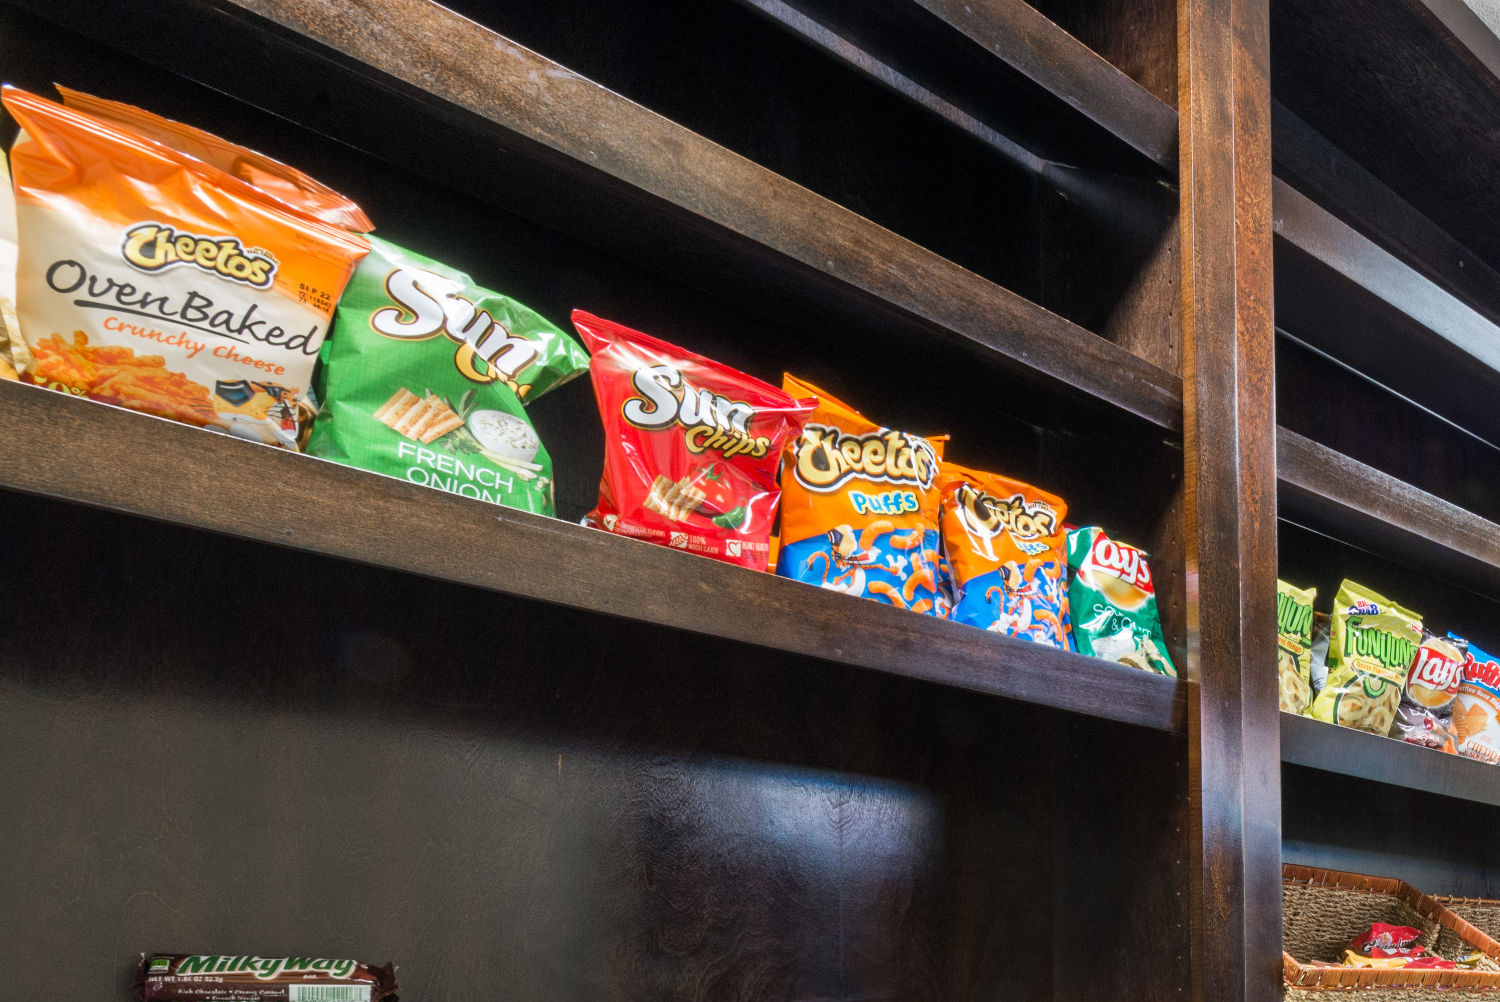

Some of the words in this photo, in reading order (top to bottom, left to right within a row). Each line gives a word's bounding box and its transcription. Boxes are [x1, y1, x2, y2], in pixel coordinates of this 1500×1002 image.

[122, 223, 278, 288] Cheetos
[45, 259, 178, 315] Oven
[179, 290, 320, 356] Baked
[369, 268, 539, 379] Sun
[622, 363, 755, 434] Sun
[398, 441, 514, 493] FRENCH
[685, 425, 773, 459] Chips
[795, 424, 935, 491] Cheetos
[849, 490, 920, 515] Puffs
